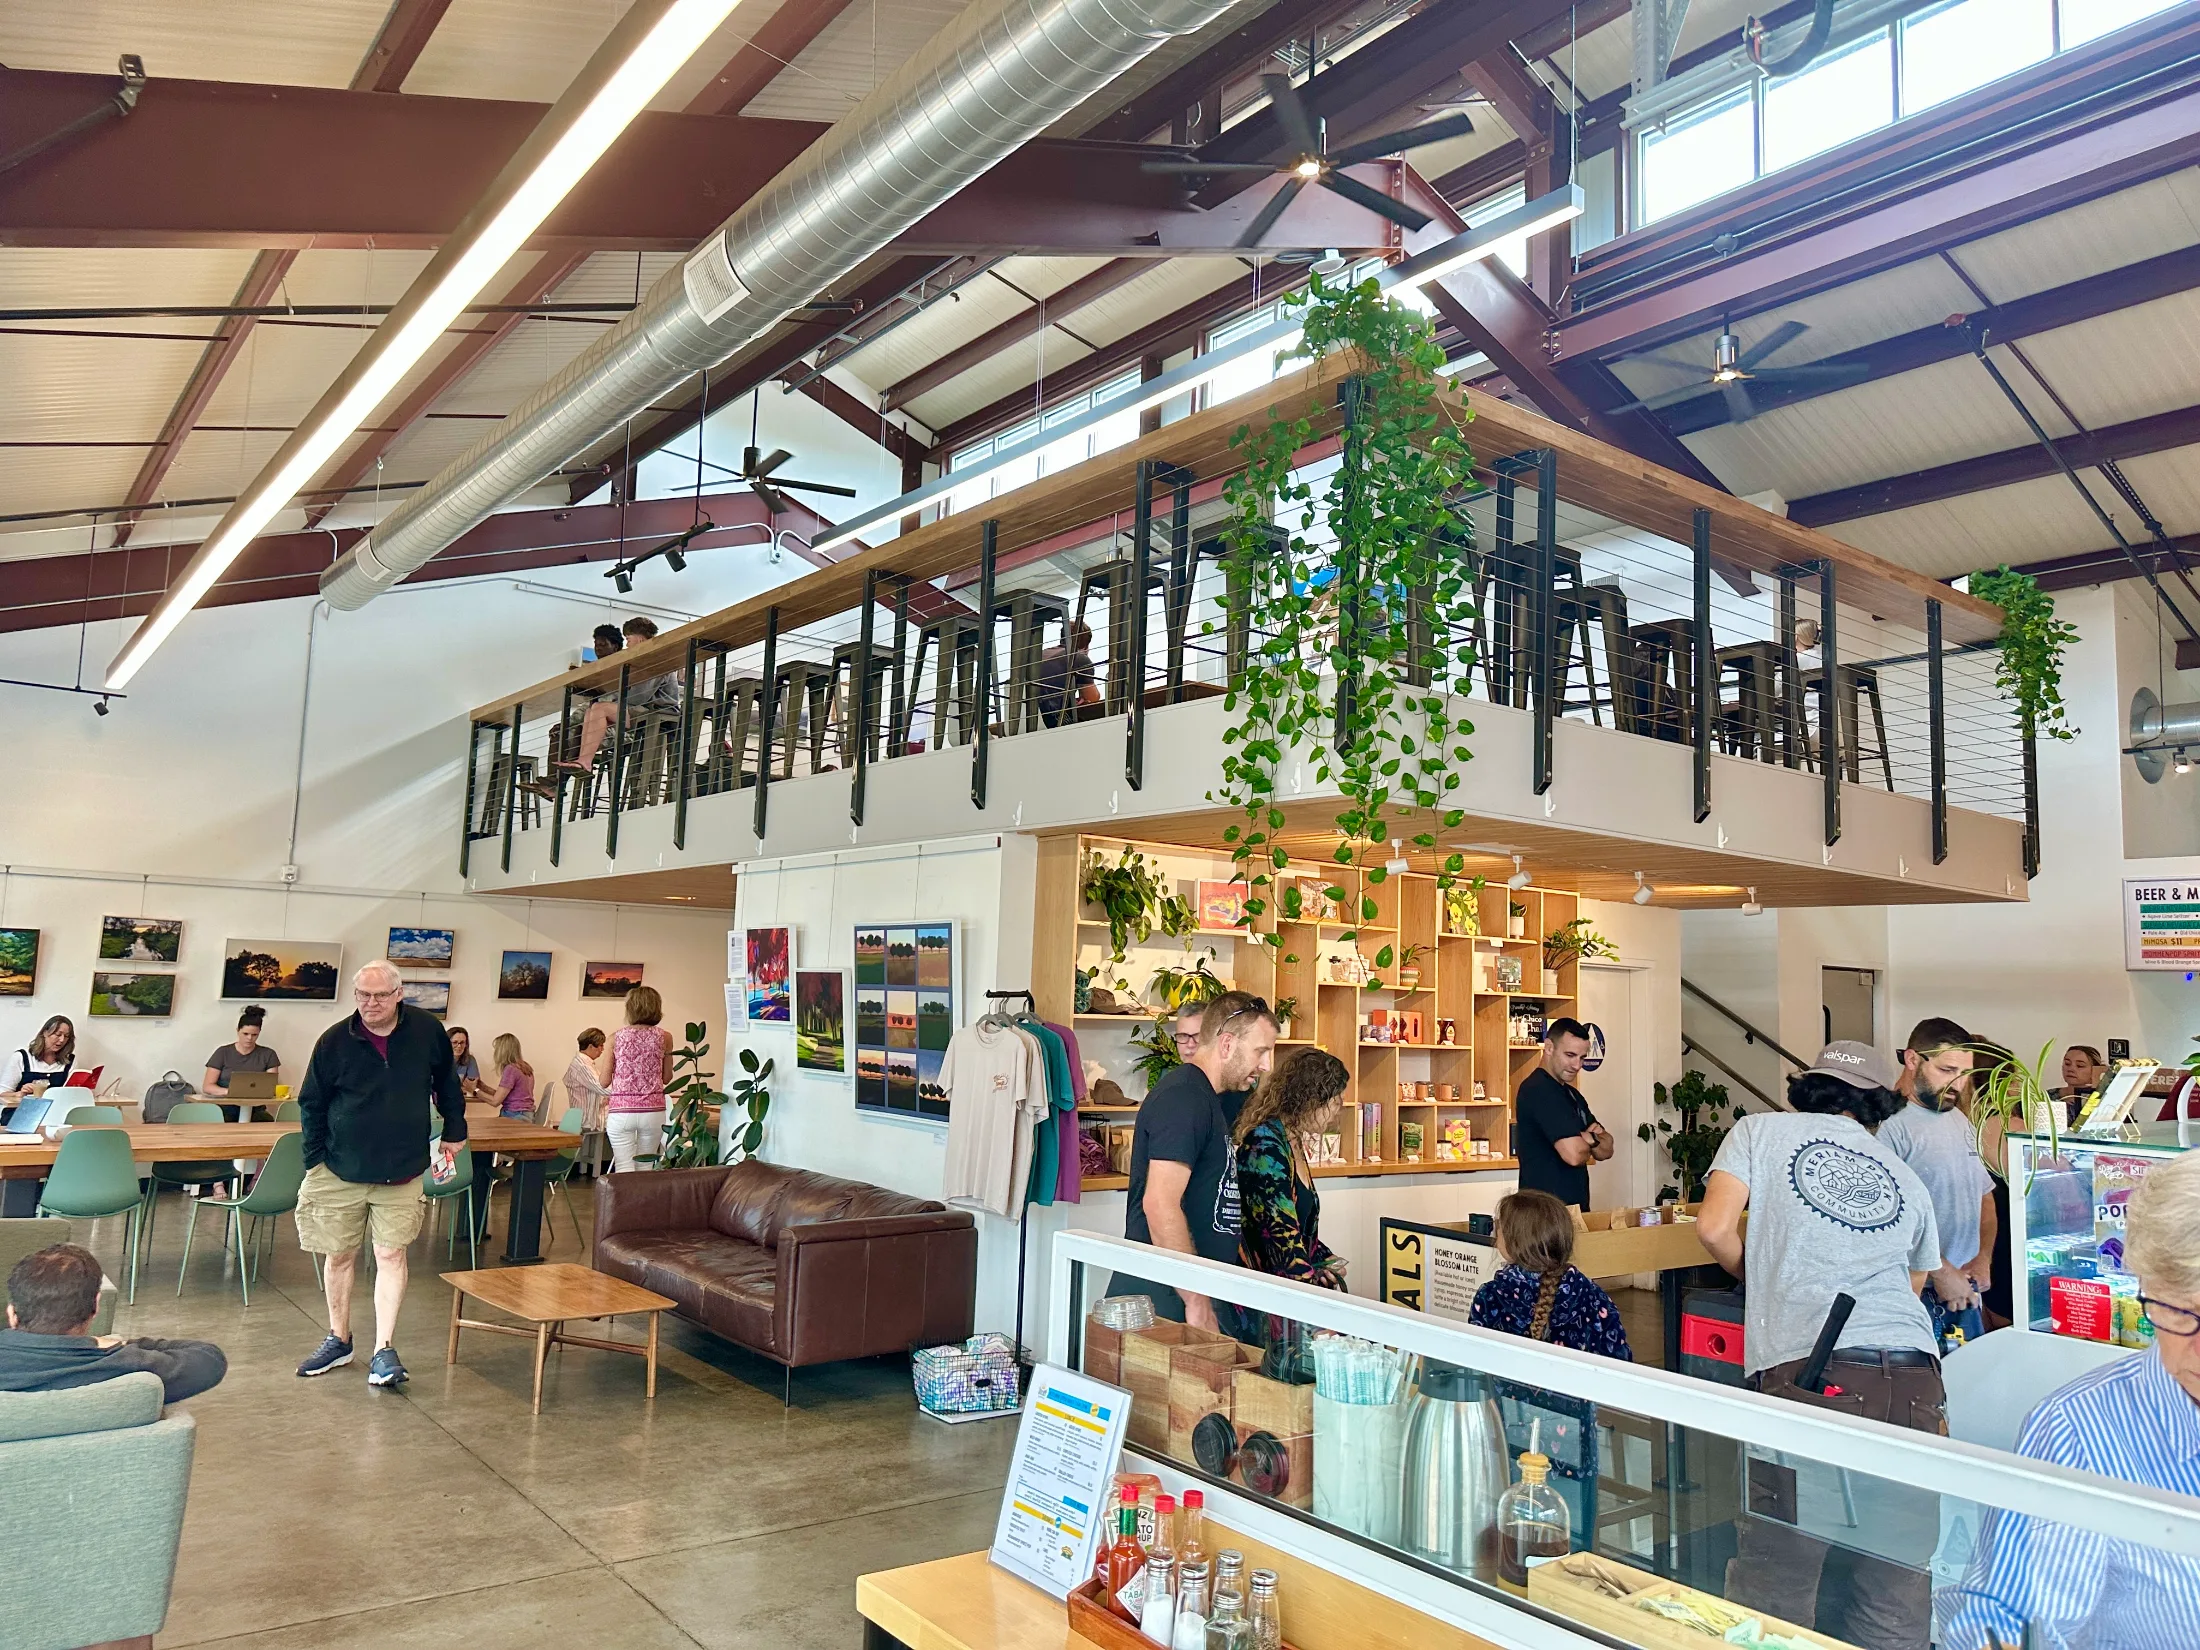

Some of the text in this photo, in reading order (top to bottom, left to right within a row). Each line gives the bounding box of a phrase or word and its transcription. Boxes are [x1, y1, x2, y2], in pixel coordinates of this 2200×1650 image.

[2135, 888, 2166, 901] BEER
[2172, 887, 2181, 900] &
[1823, 1049, 1866, 1065] valspar
[1805, 1150, 1892, 1202] MERIAM PARK
[1810, 1185, 1886, 1219] COMMUNITY
[1434, 1248, 1477, 1264] HONEY ORANGE
[1434, 1258, 1479, 1275] BLOSSOM LATTE
